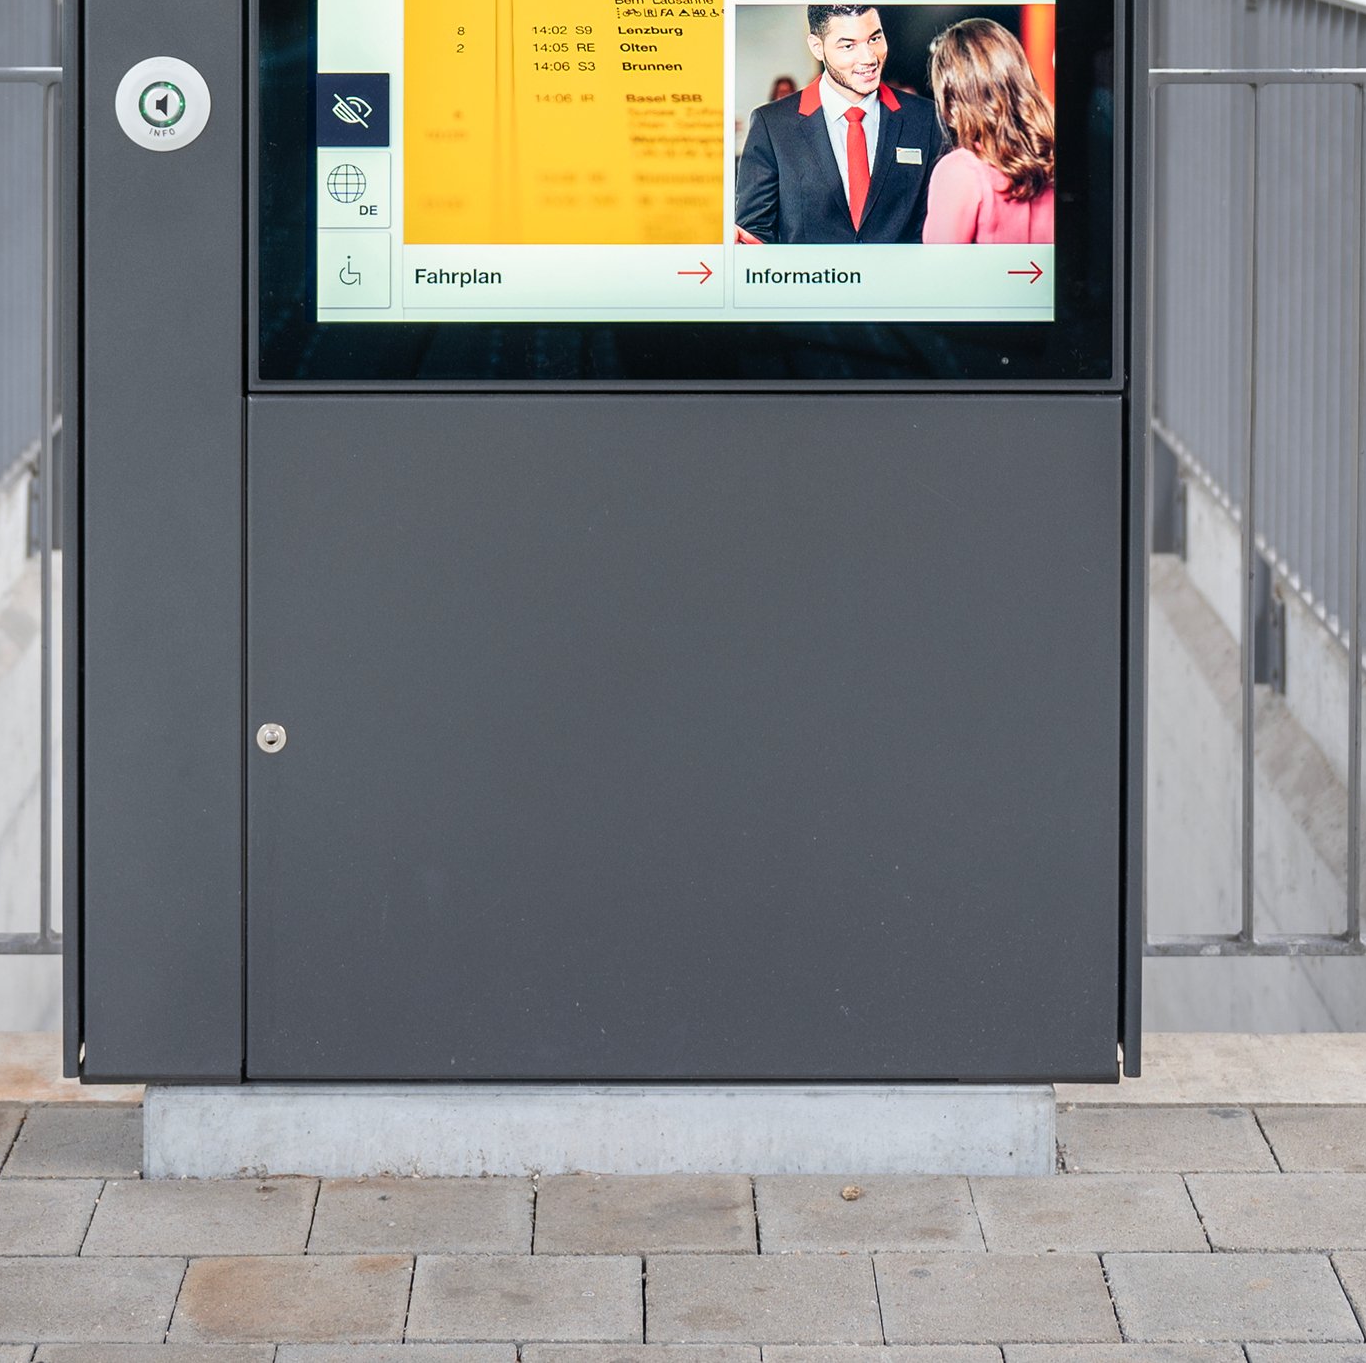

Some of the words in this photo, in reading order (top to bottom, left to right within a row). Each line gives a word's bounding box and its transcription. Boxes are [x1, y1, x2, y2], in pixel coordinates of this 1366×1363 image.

[660, 8, 674, 17] FA
[457, 26, 465, 35] 8
[533, 26, 567, 34] 14:02
[576, 26, 592, 34] S9
[618, 27, 683, 36] Lenzburg
[456, 43, 465, 53] 2
[533, 43, 568, 52] 14:05
[577, 43, 595, 52] RE
[620, 43, 657, 52] Olten
[535, 62, 570, 71] 14:06
[578, 62, 595, 71] S3
[622, 62, 682, 71] Brunnen
[626, 94, 666, 103] Basel
[671, 94, 702, 103] SBB
[149, 127, 176, 137] INFO
[360, 205, 377, 215] DE
[416, 269, 501, 287] Fahrplan
[747, 269, 860, 283] Information
